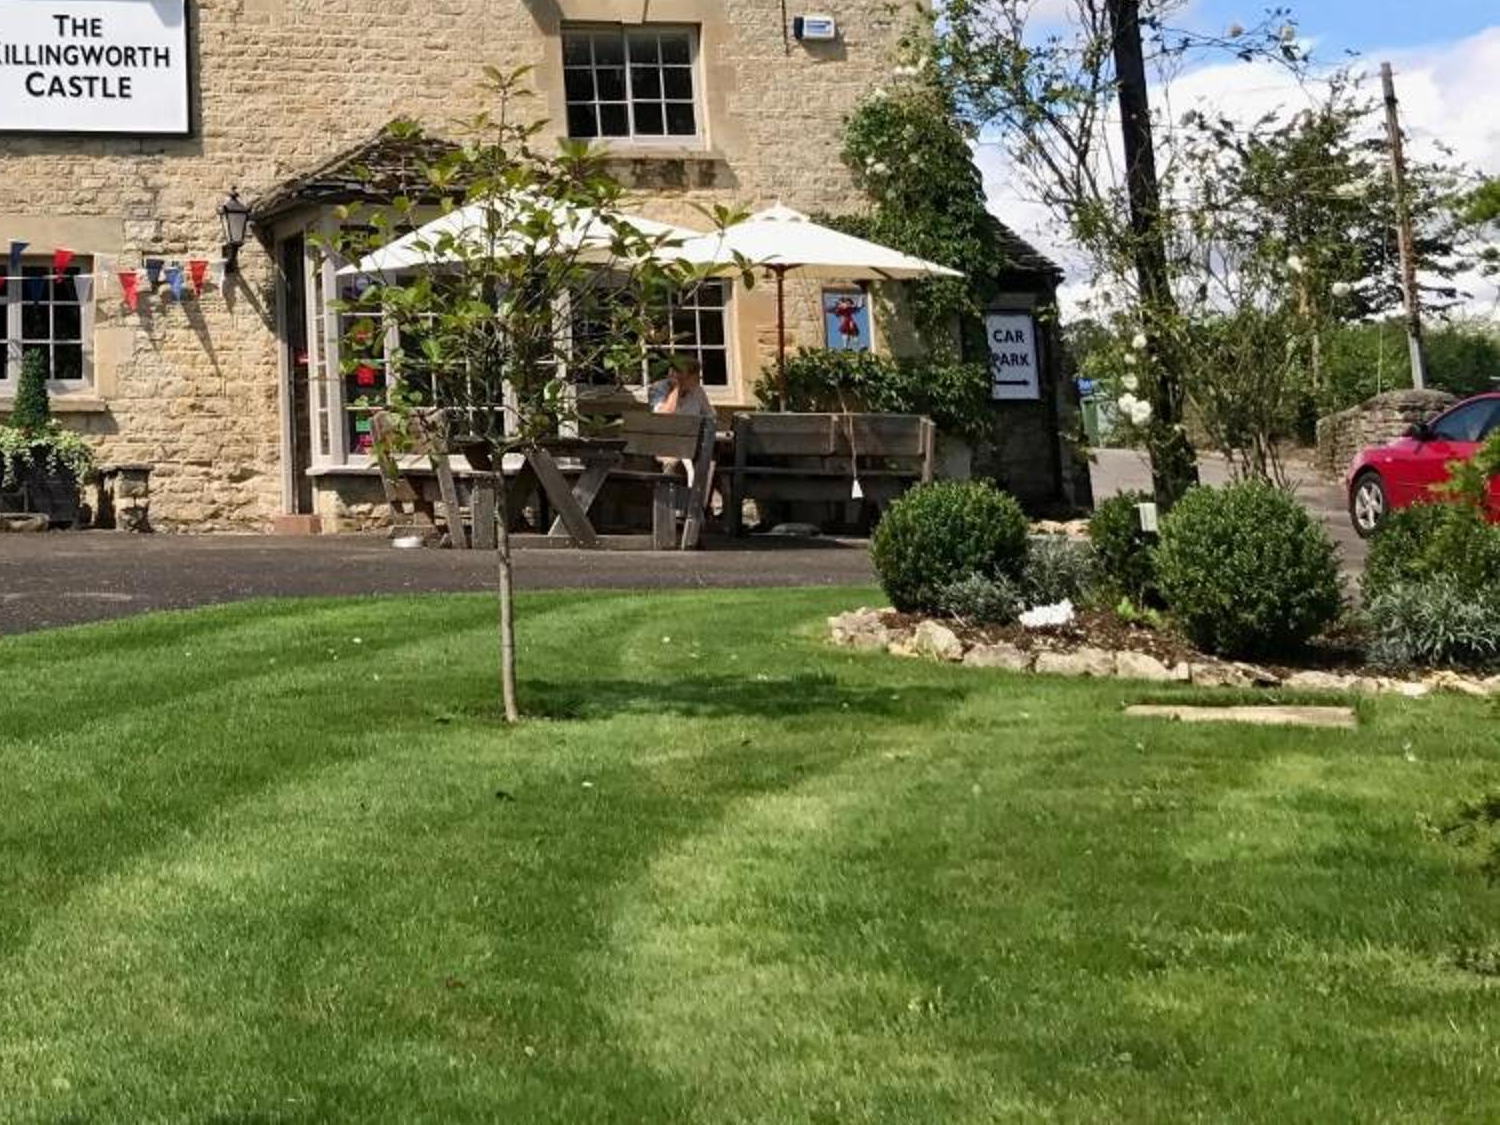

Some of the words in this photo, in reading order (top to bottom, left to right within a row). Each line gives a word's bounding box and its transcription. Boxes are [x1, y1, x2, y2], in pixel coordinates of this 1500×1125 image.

[52, 14, 103, 38] THE
[25, 71, 132, 99] CASTLE
[993, 330, 1025, 344] CAR
[992, 353, 1029, 367] PARK
